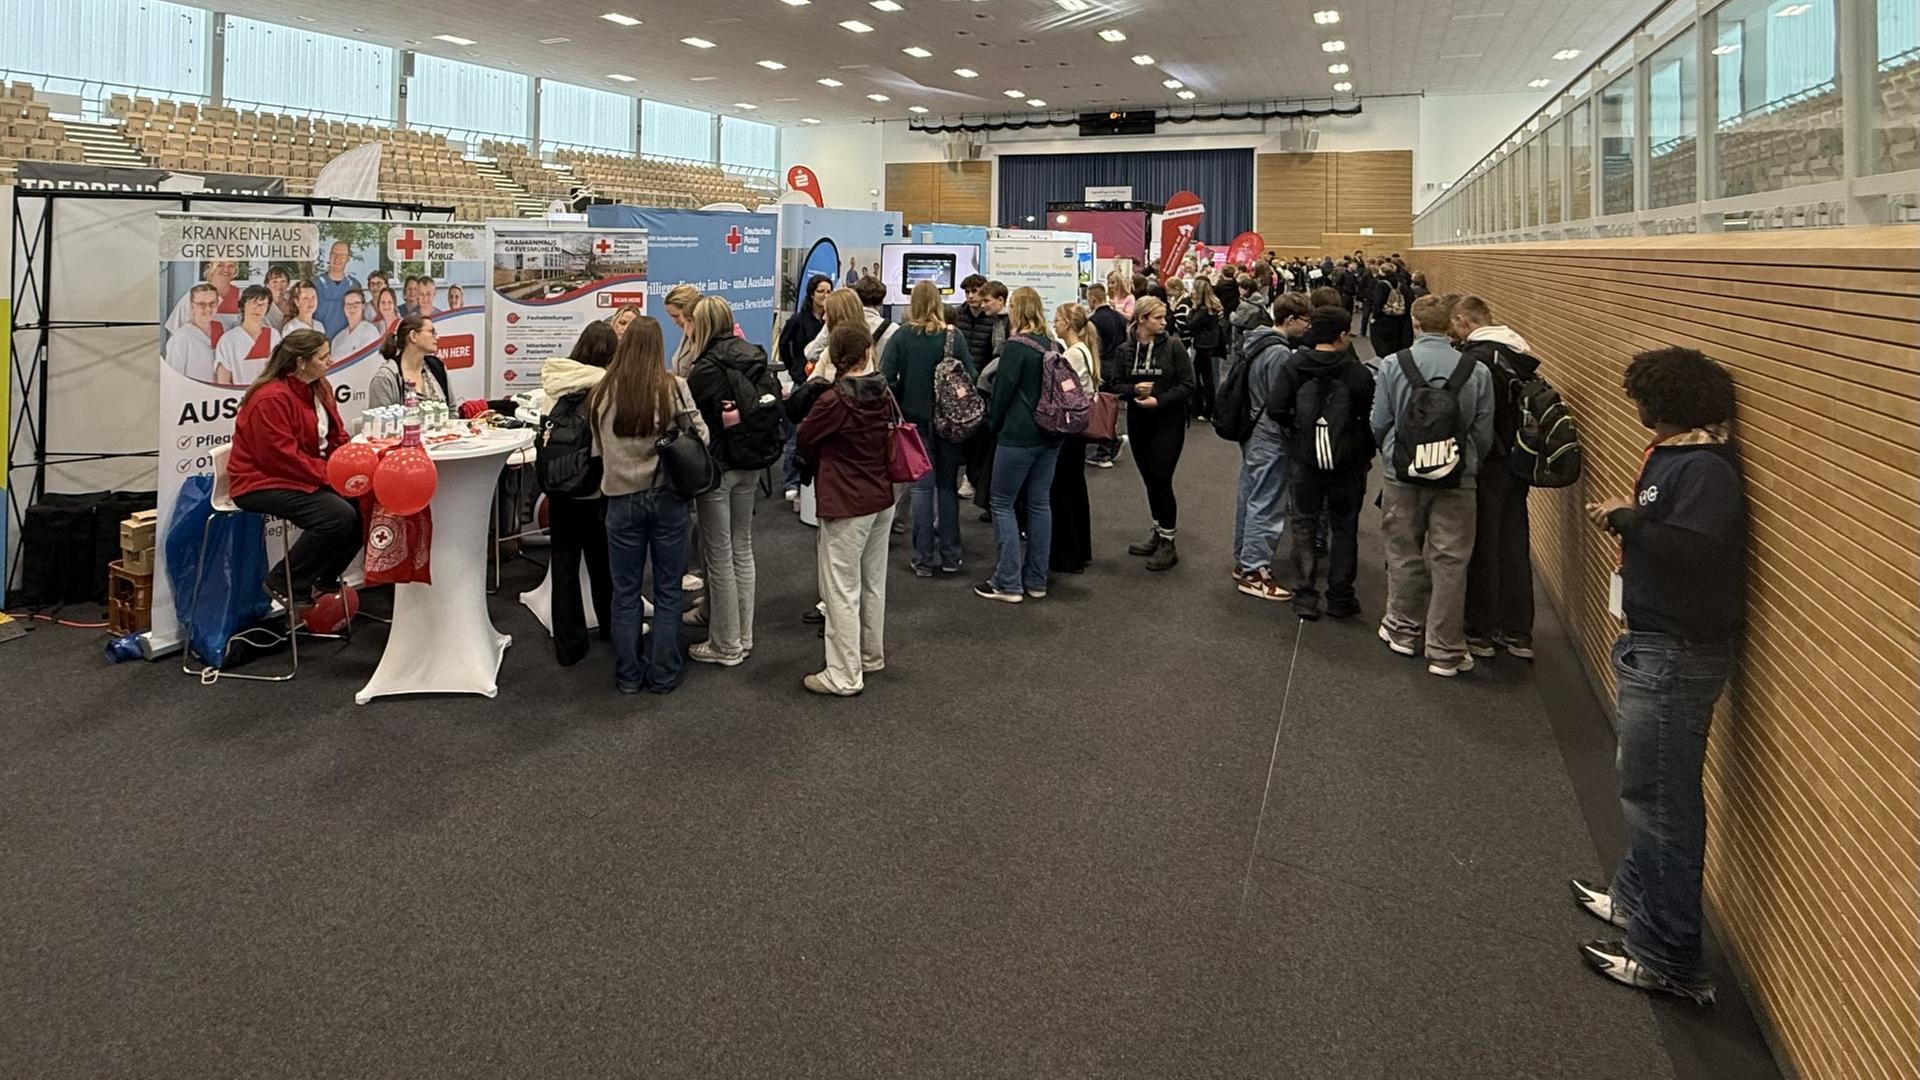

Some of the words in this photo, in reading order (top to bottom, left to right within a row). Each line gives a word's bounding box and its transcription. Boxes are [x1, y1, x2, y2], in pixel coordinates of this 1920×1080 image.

[182, 226, 301, 241] KRANKENHAUS
[428, 229, 475, 240] Deutsches
[744, 226, 771, 235] Deutsches
[428, 240, 454, 250] Rotes
[744, 236, 760, 244] Rotes
[181, 241, 310, 258] GREVESMÜHLEN
[743, 245, 759, 253] Kreuz
[428, 251, 454, 261] Kreuz
[708, 279, 719, 291] im
[733, 277, 747, 289] und
[747, 275, 775, 288] Ausland
[450, 346, 471, 356] HERE
